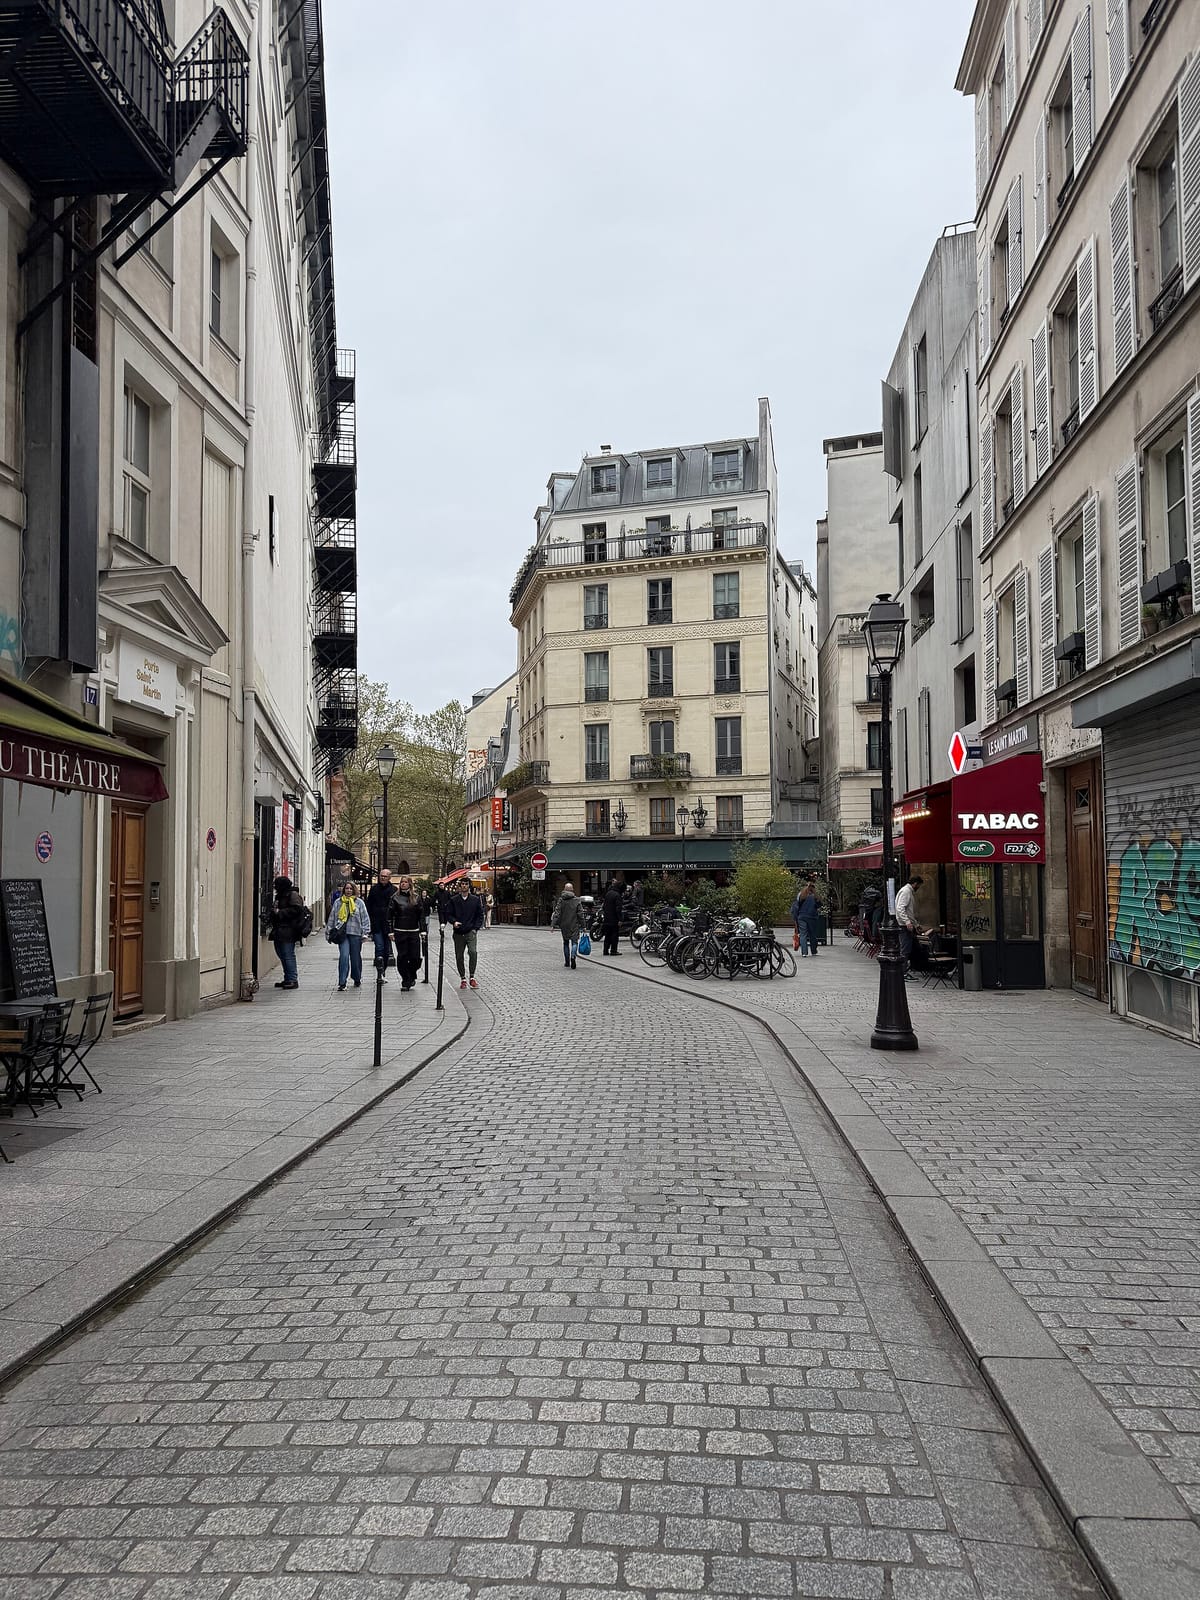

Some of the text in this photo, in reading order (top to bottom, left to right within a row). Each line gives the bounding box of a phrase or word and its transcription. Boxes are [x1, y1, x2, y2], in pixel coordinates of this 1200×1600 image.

[144, 658, 159, 674] Porte
[86, 687, 96, 704] 17
[143, 684, 161, 700] Martin
[988, 724, 1028, 756] LE SAINT MARTIN
[22, 745, 121, 792] THÉÂTRE
[958, 813, 1039, 829] TABAC
